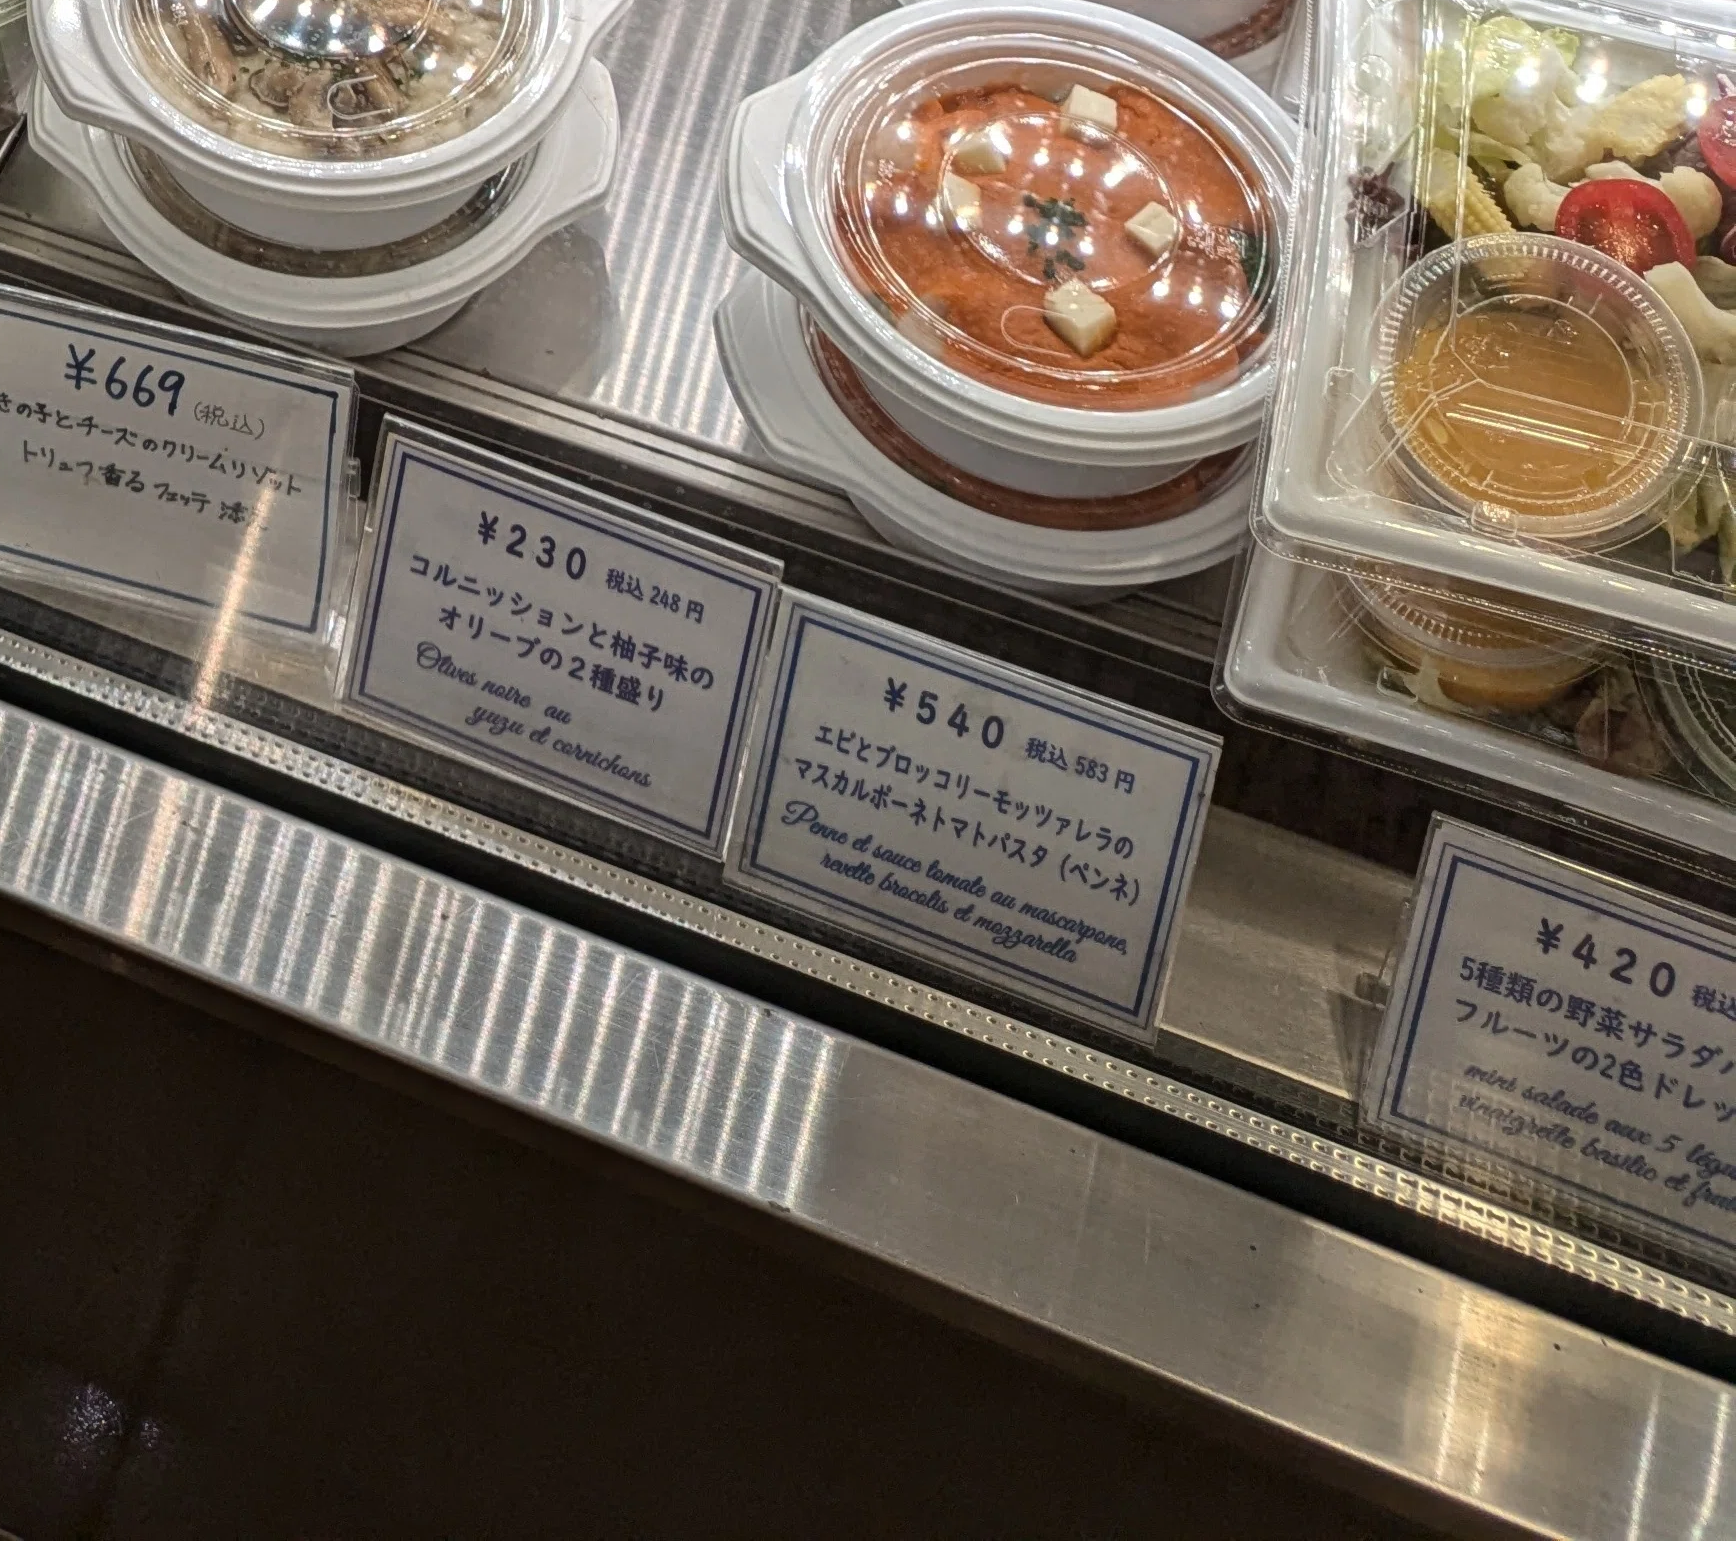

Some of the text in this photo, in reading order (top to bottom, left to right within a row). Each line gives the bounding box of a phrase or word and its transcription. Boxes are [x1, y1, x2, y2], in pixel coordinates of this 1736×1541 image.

[64, 344, 186, 416] ¥669
[477, 511, 587, 580] ¥230
[409, 553, 714, 692] コルニッションと柚子味の
[439, 605, 665, 713] オリーブの2種盛り
[416, 641, 572, 725] Olives noire au
[884, 676, 1005, 749] ¥540
[465, 706, 652, 788] yuzu et cornichons
[815, 724, 1134, 861] エビとブロッコリーモッツァレラの
[780, 799, 848, 845] Penne
[852, 835, 873, 852] et
[872, 844, 922, 873] sauce
[925, 860, 987, 898] tomate
[990, 890, 1016, 910] au
[878, 872, 1077, 963] brocolis et mozzarella
[1536, 917, 1676, 998] ¥420
